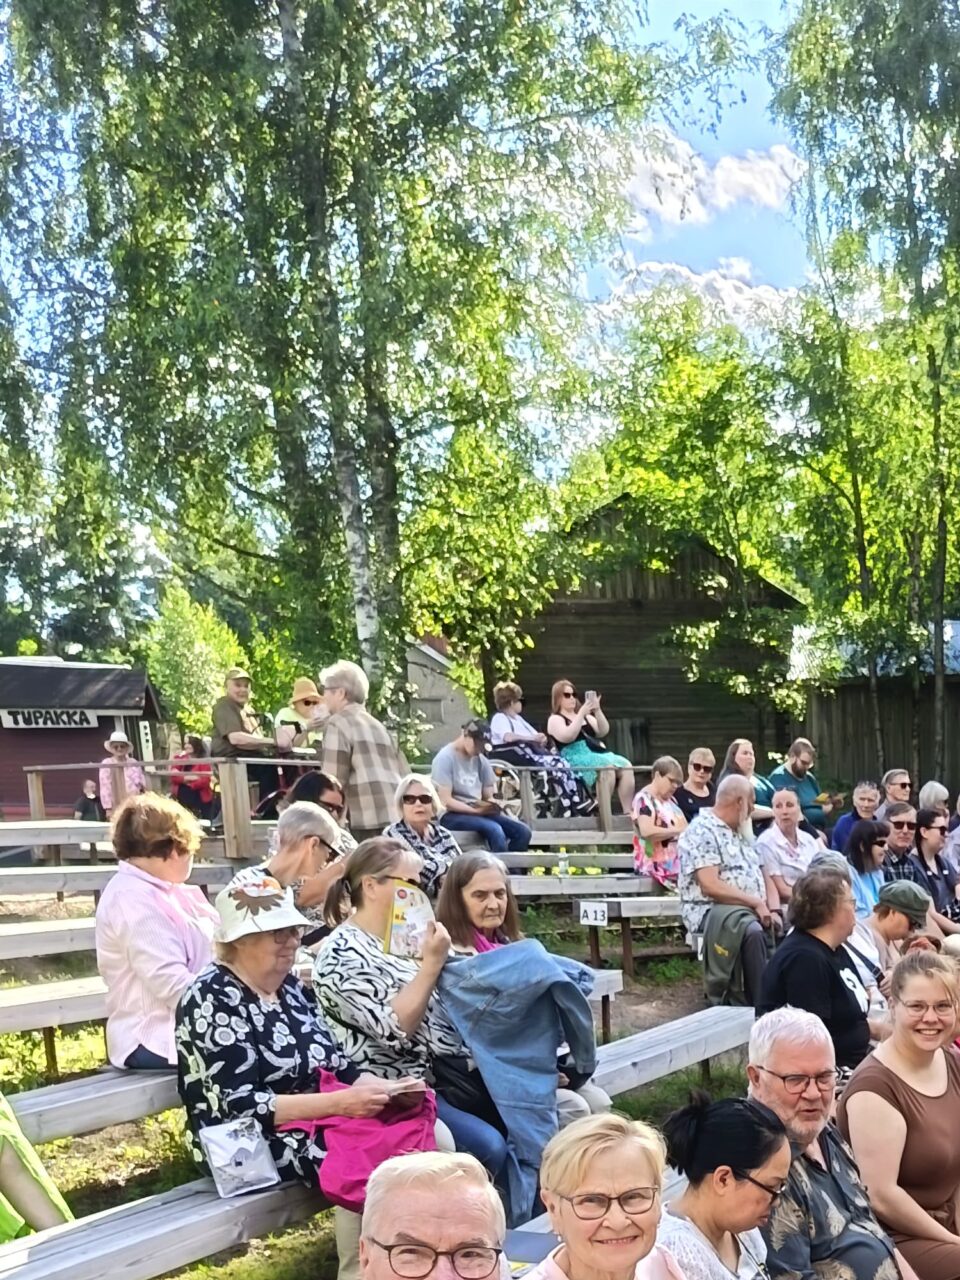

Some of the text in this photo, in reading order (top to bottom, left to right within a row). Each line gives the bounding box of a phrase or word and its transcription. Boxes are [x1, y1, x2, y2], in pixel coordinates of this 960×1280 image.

[8, 710, 91, 726] TUPAKKA
[582, 909, 606, 922] A 13
